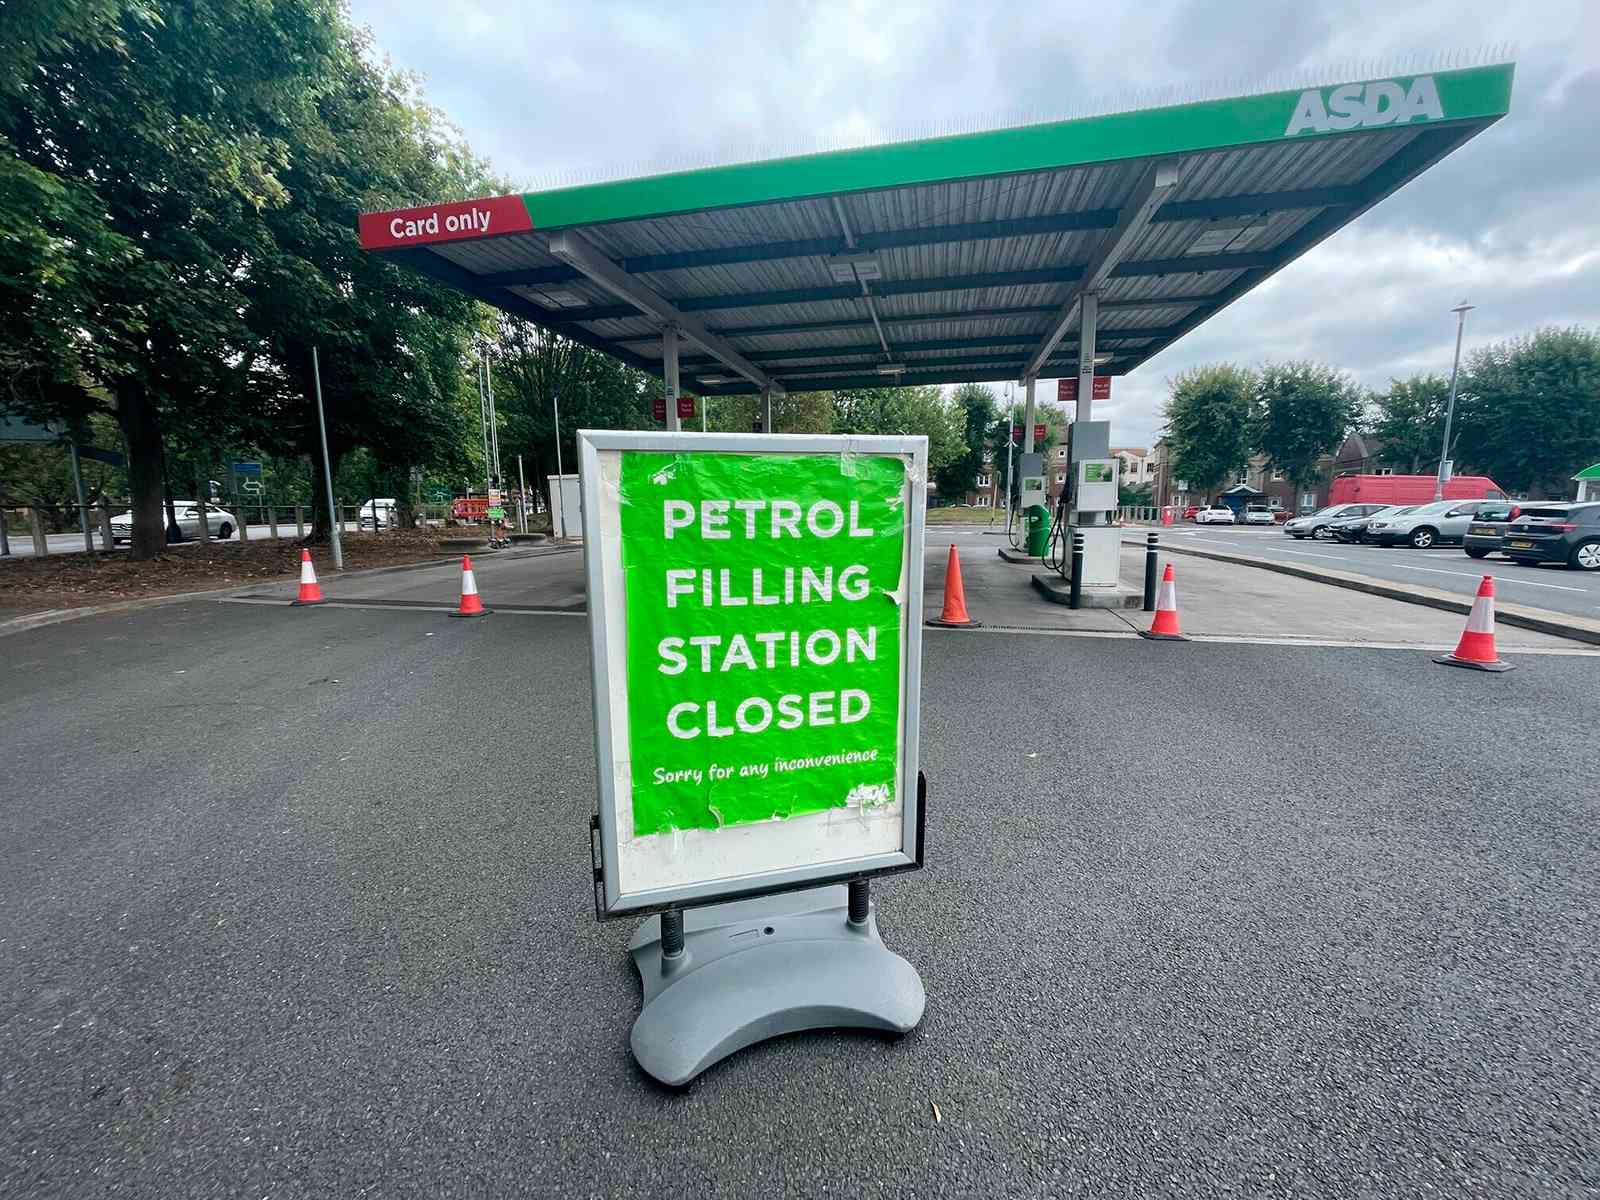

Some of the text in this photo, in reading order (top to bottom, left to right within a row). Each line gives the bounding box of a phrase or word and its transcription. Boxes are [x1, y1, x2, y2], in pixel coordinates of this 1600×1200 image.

[1284, 75, 1445, 136] ASDA
[390, 207, 491, 239] Card only
[663, 499, 874, 539] PETROL
[666, 565, 871, 608] FILLING
[657, 626, 877, 675] STATION
[666, 689, 871, 739] CLOSED
[652, 748, 879, 786] Sorry for any inconvenience
